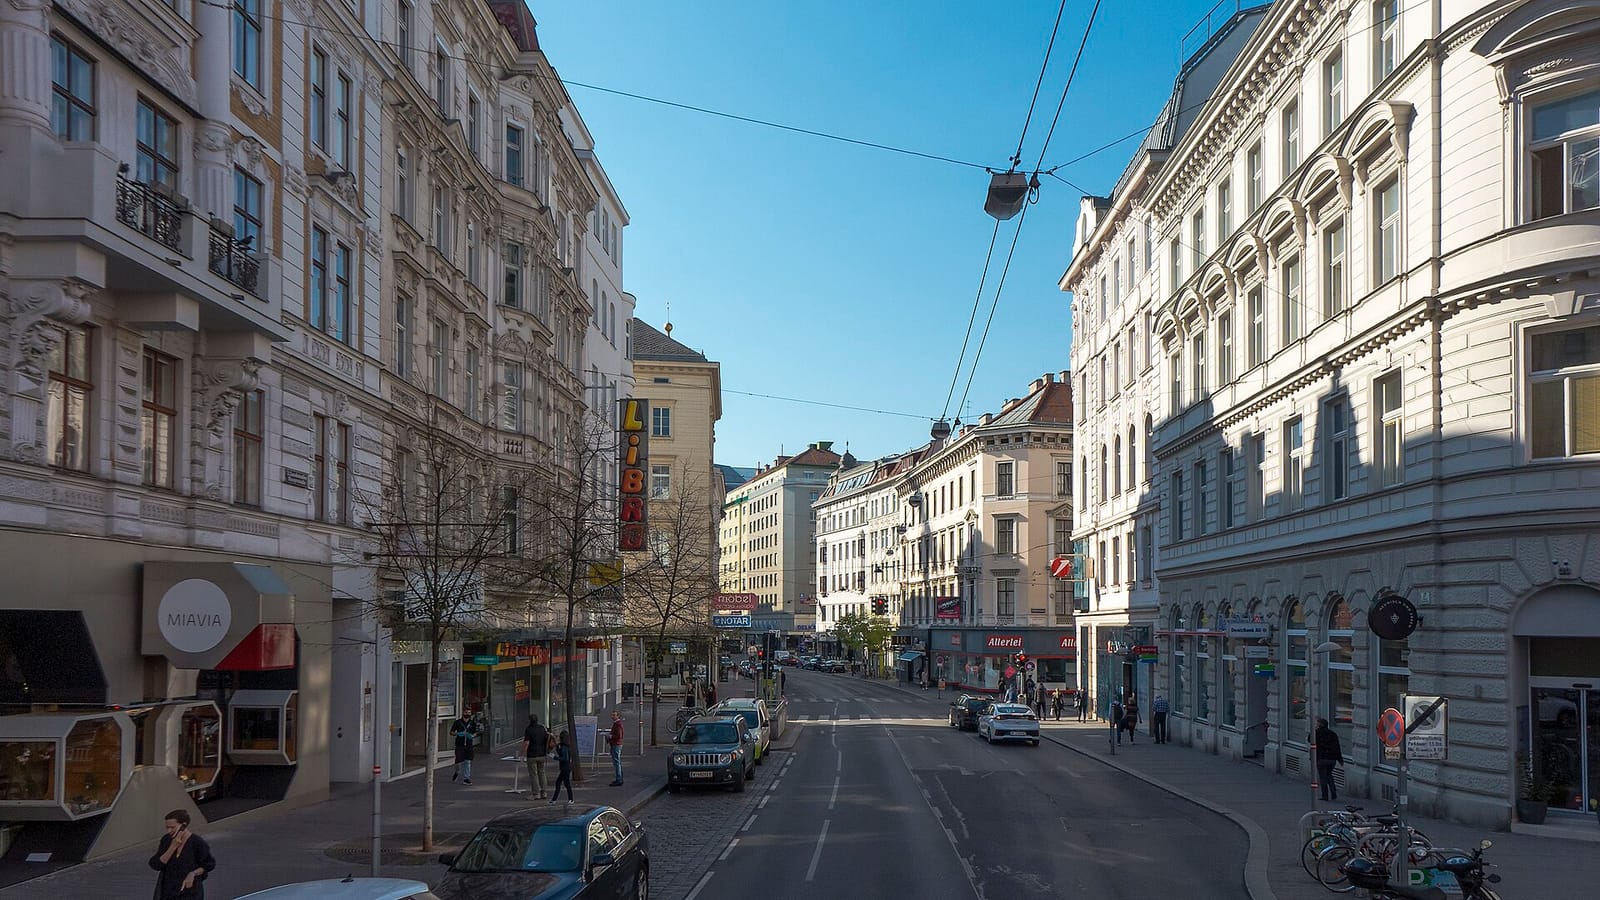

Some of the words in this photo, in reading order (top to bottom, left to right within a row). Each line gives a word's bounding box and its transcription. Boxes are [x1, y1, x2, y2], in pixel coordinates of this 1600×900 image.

[167, 613, 222, 627] MIAVIA
[720, 617, 748, 625] NOTAR
[988, 637, 1022, 647] Allerlei
[1061, 638, 1076, 647] All
